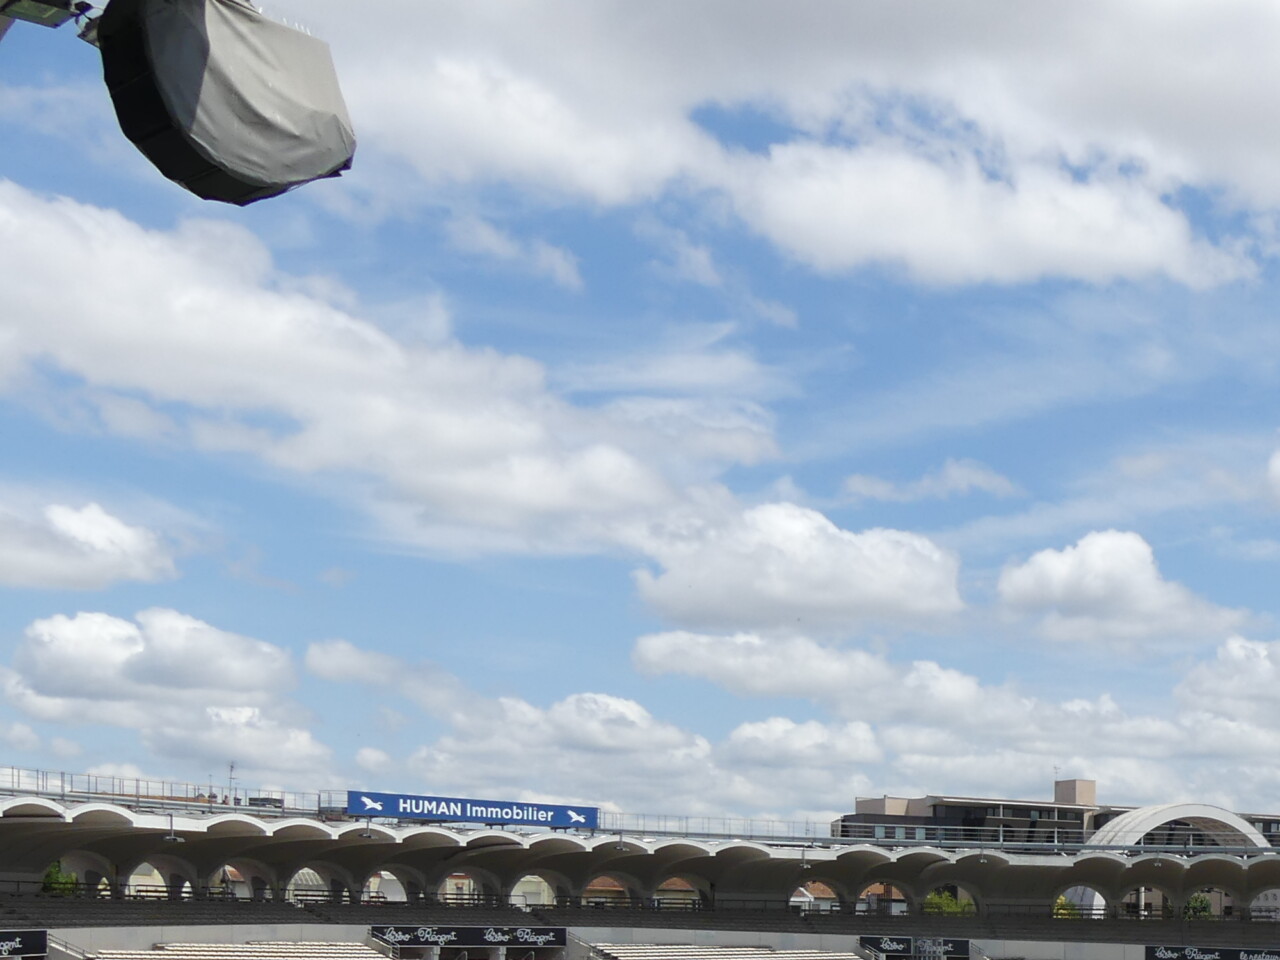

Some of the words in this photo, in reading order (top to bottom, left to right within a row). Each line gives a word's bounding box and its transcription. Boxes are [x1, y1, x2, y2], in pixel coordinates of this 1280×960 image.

[399, 799, 462, 816] HUMAN
[466, 803, 554, 821] Immobilier
[1240, 951, 1249, 960] le
